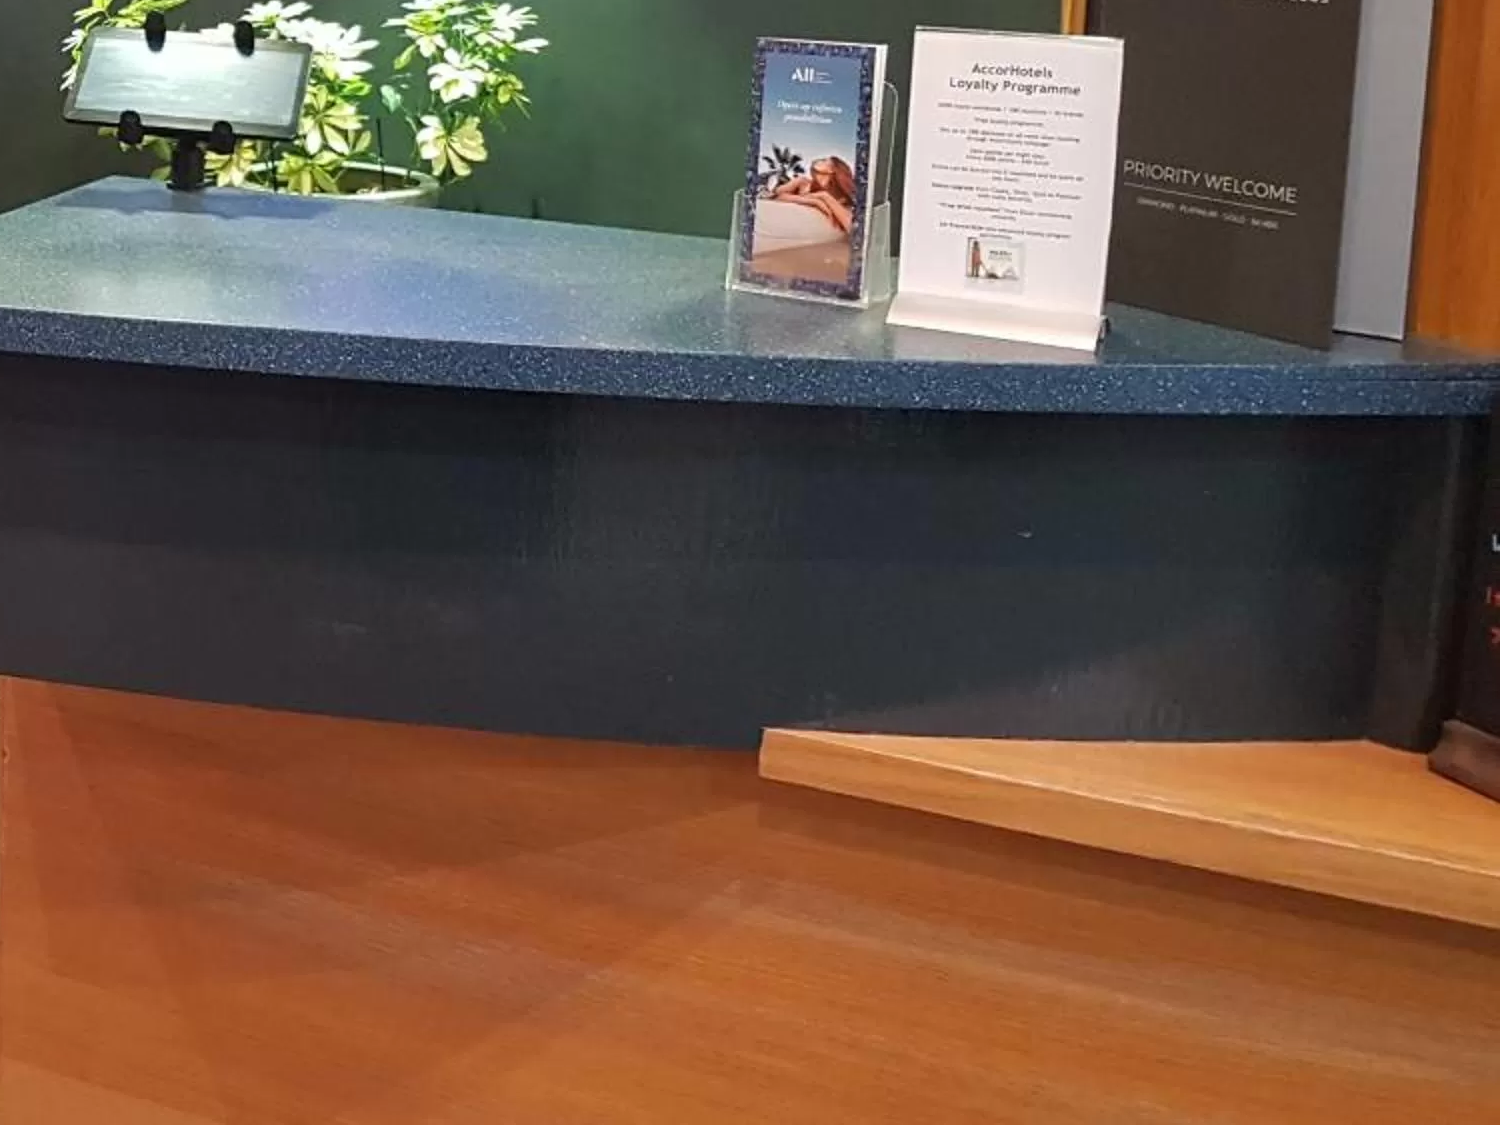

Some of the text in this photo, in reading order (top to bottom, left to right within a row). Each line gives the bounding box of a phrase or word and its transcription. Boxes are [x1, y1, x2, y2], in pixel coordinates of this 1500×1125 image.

[971, 62, 1053, 79] AccorHotels
[949, 77, 1082, 96] Loyalty Programme
[1123, 159, 1298, 204] PRIORITY WELCOME
